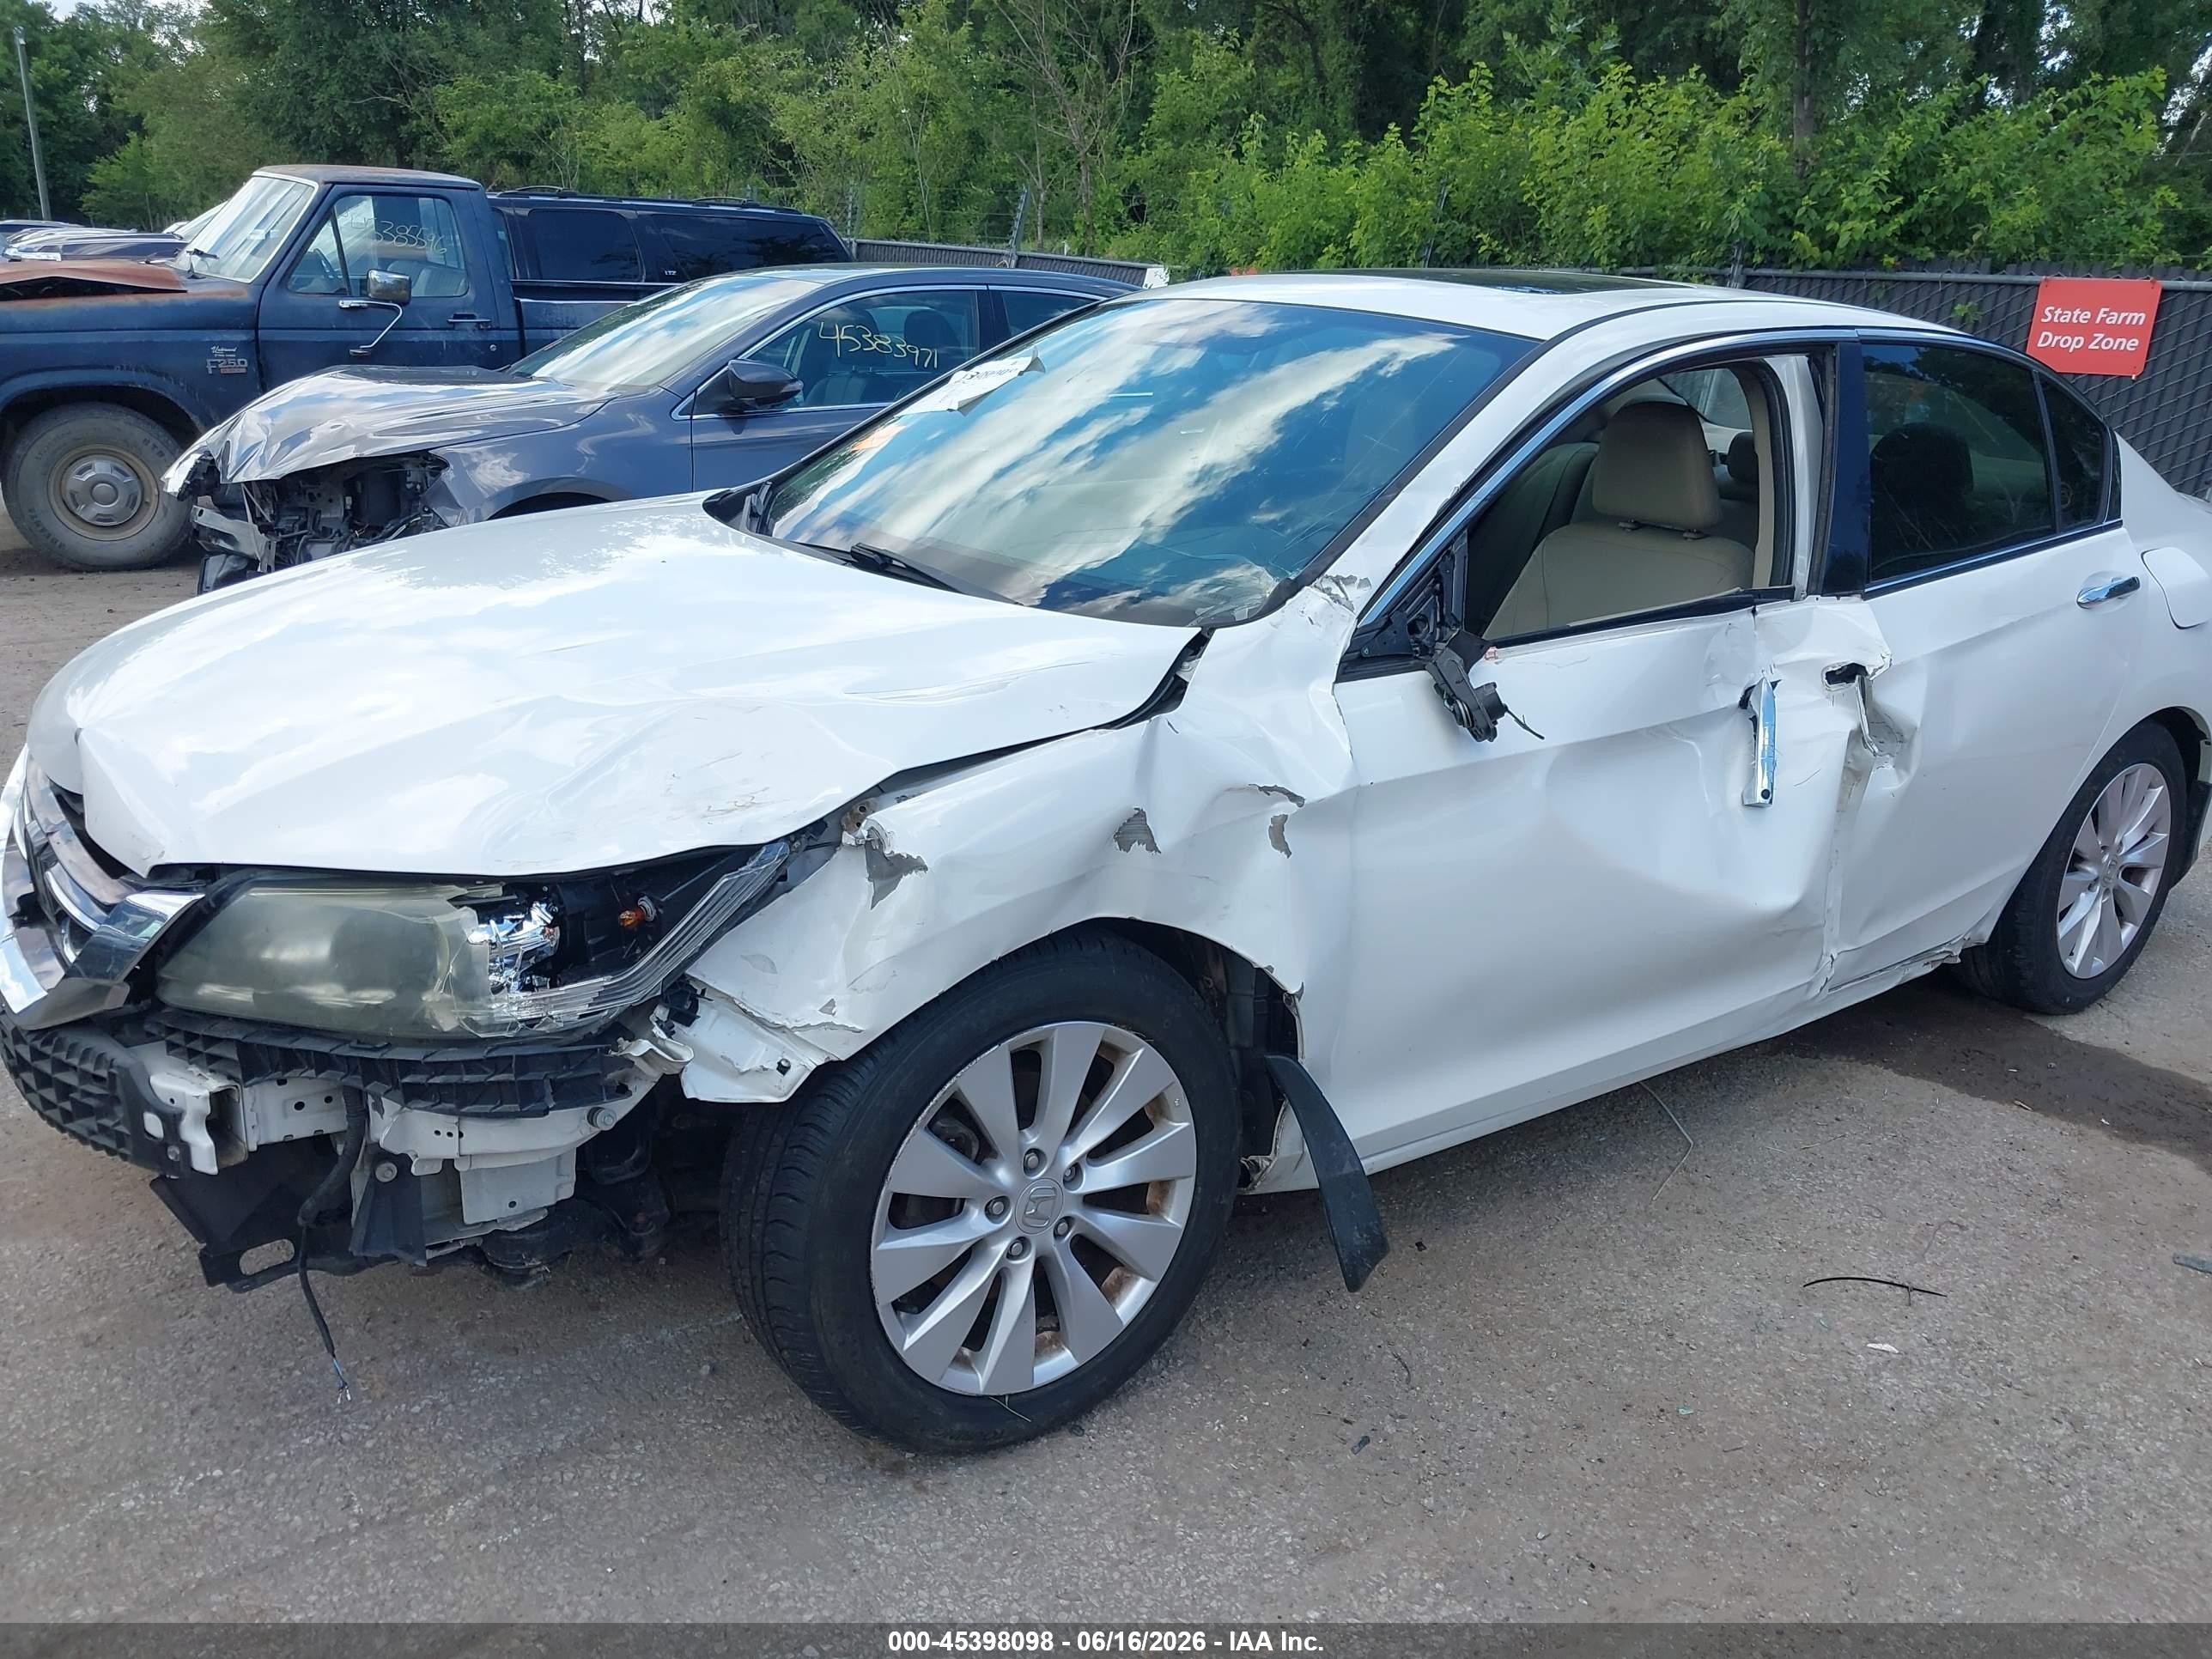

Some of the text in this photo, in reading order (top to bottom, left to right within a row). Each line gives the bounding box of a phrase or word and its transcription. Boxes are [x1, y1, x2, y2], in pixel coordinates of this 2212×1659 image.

[2040, 306, 2146, 325] State Farm
[818, 321, 938, 369] 45383971
[2037, 331, 2139, 353] Drop Zone
[206, 358, 248, 374] F250
